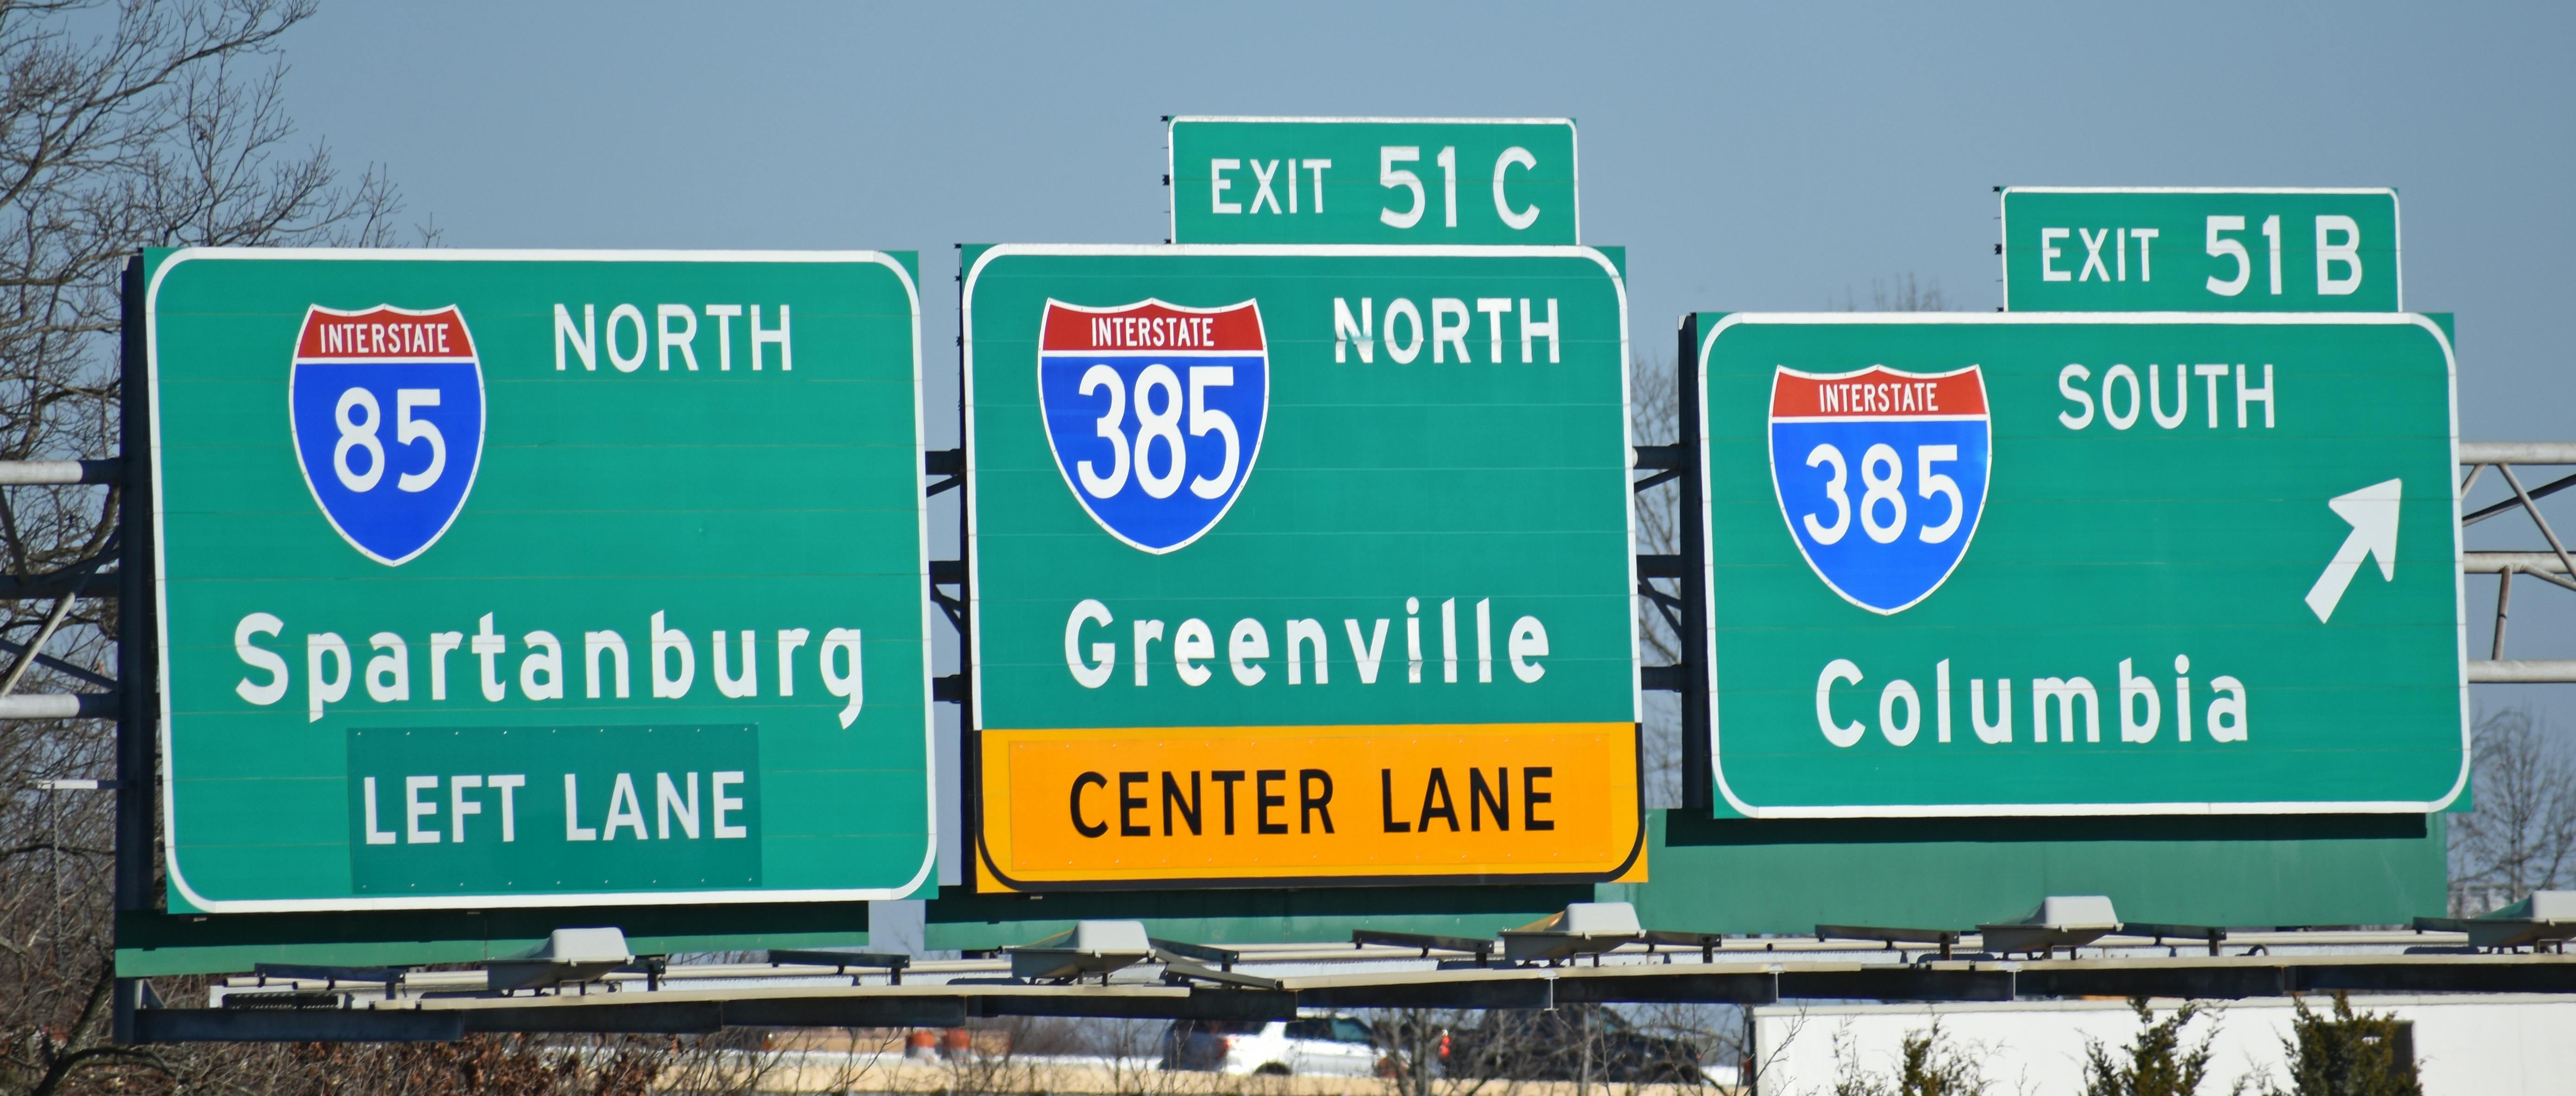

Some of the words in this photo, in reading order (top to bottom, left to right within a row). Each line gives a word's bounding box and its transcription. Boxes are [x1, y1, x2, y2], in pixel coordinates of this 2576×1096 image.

[1211, 159, 1332, 214] EXIT
[1380, 146, 1457, 229] 51
[1492, 146, 1540, 230] C
[2042, 228, 2159, 282] EXIT
[2206, 215, 2282, 296] 51
[2316, 215, 2362, 295] B
[320, 323, 450, 355] INTERSTATE
[554, 303, 792, 373] NORTH
[1091, 317, 1215, 347] INTERSTATE
[1333, 297, 1560, 364] NORTH
[1076, 363, 1240, 500] 385
[1818, 382, 1939, 413] INTERSTATE
[2058, 363, 2275, 430] SOUTH
[334, 387, 446, 492] 85
[1803, 443, 1963, 546] 385
[235, 610, 863, 730] Spartanburg
[1064, 597, 1549, 689] Greenville
[1816, 654, 2248, 748] Columbia
[364, 774, 525, 845] LEFT
[565, 771, 747, 841] LANE
[1070, 769, 1335, 838] CENTER
[1381, 766, 1554, 833] LANE
